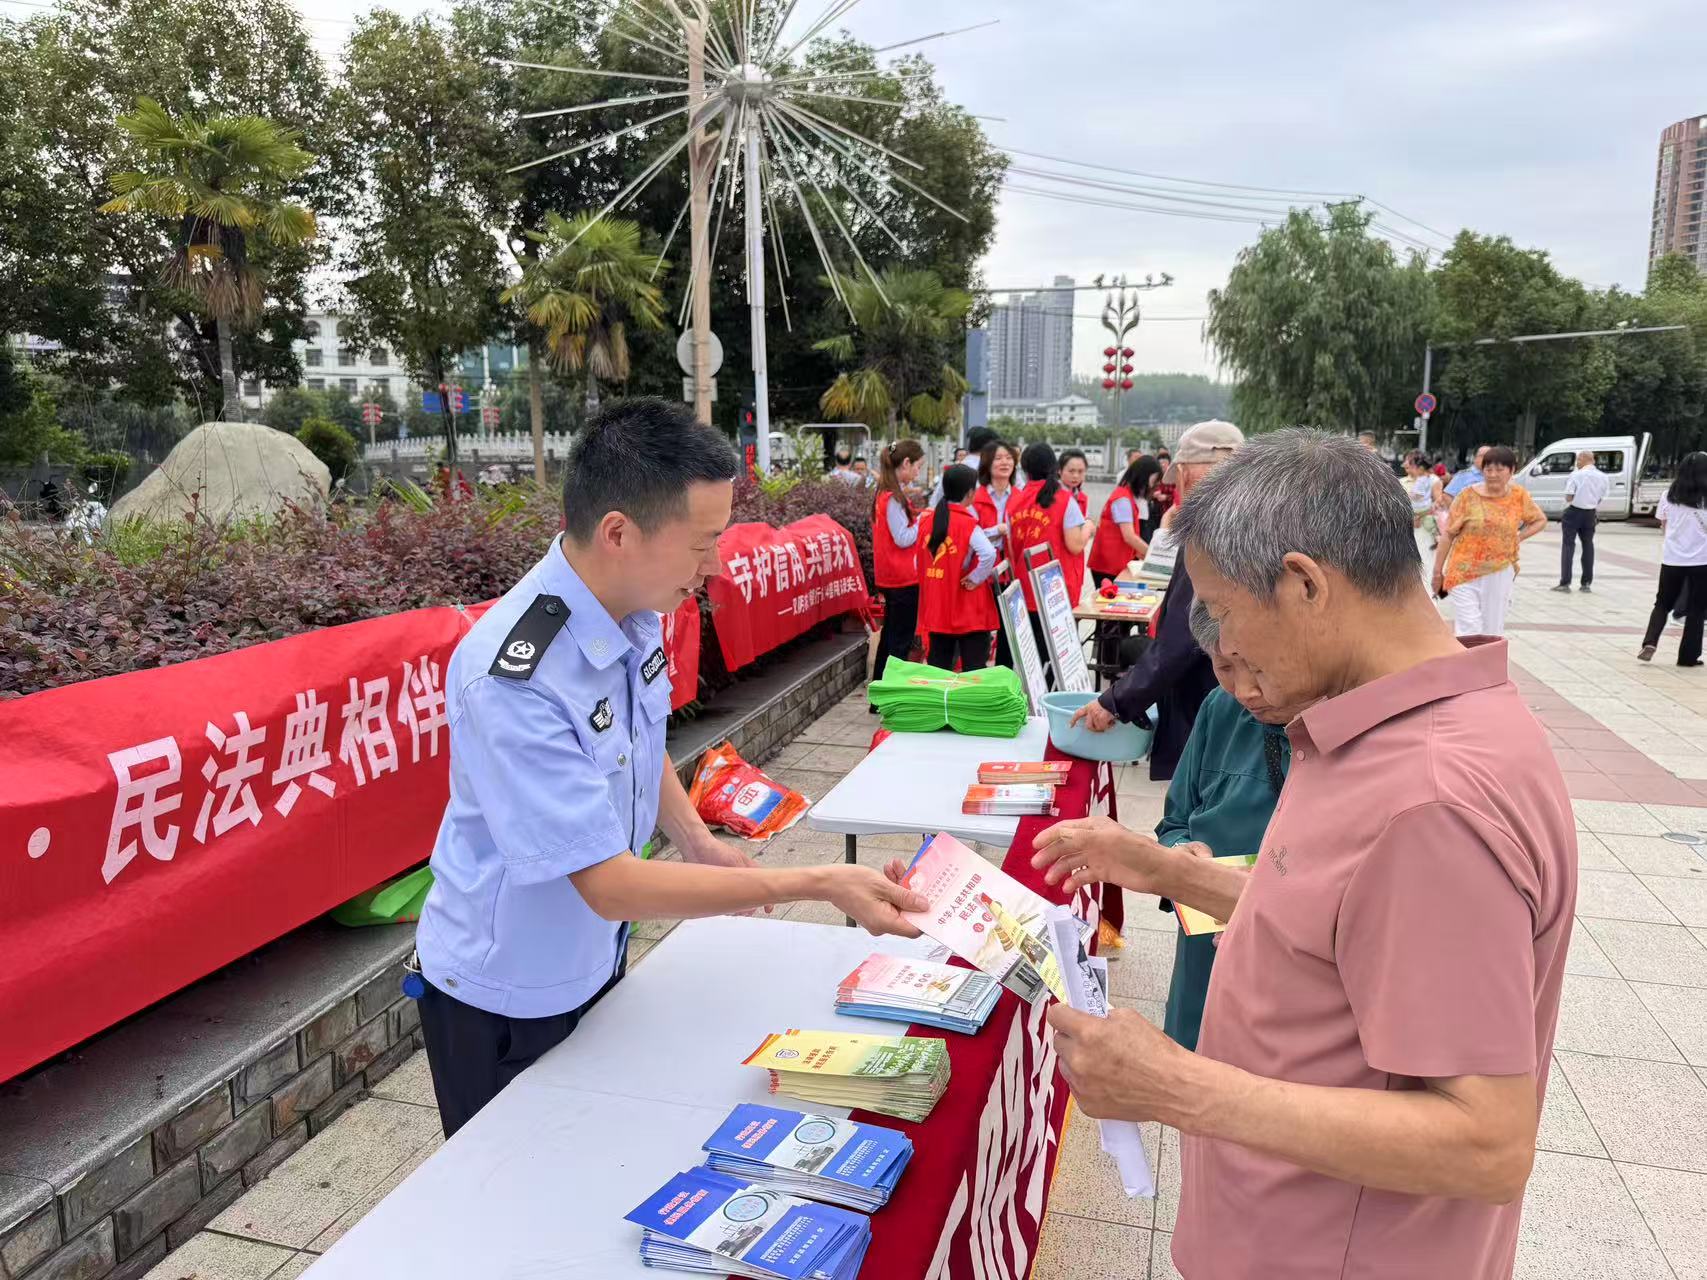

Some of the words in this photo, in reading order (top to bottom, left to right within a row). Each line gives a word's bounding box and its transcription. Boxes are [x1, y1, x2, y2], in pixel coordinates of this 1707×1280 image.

[727, 541, 805, 604] 守护信用
[937, 873, 982, 925] 中华人民共和国
